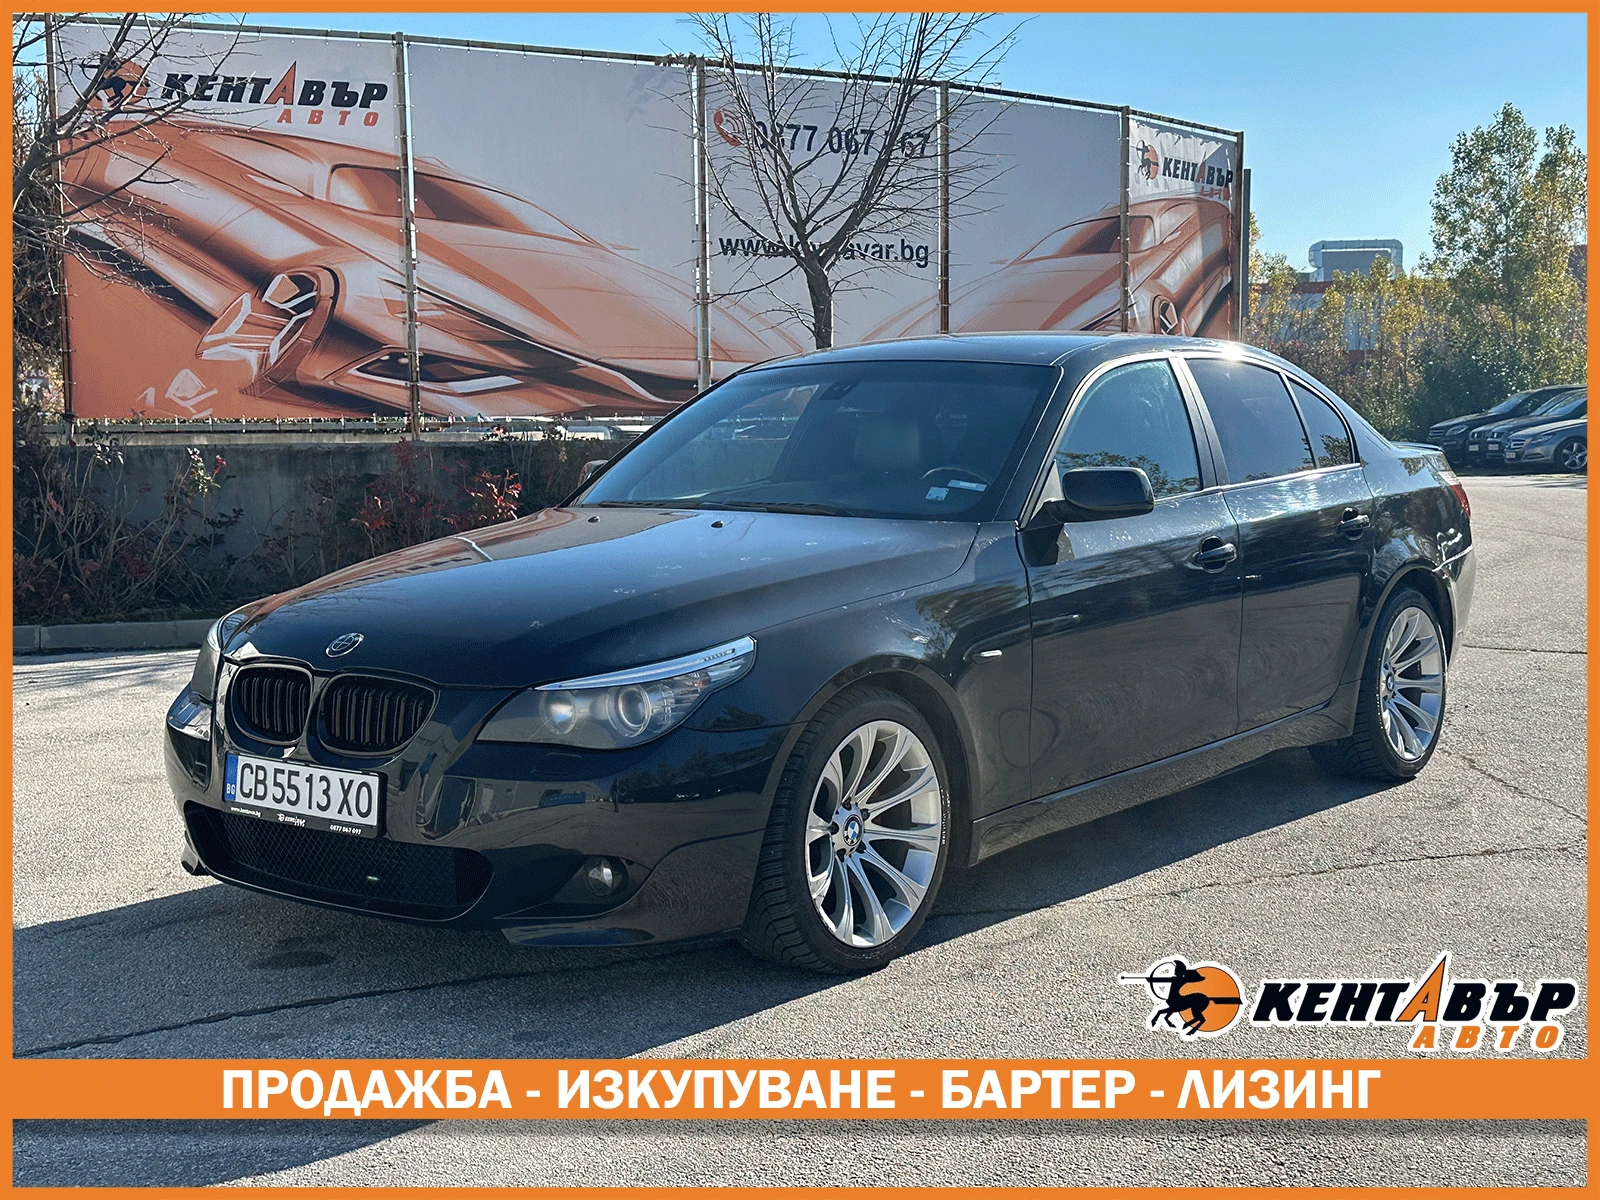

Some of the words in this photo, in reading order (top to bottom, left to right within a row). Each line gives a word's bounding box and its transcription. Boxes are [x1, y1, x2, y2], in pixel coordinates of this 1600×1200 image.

[161, 61, 388, 109] КЕНТАВЪР
[277, 108, 379, 127] АВТО
[226, 783, 236, 795] BG
